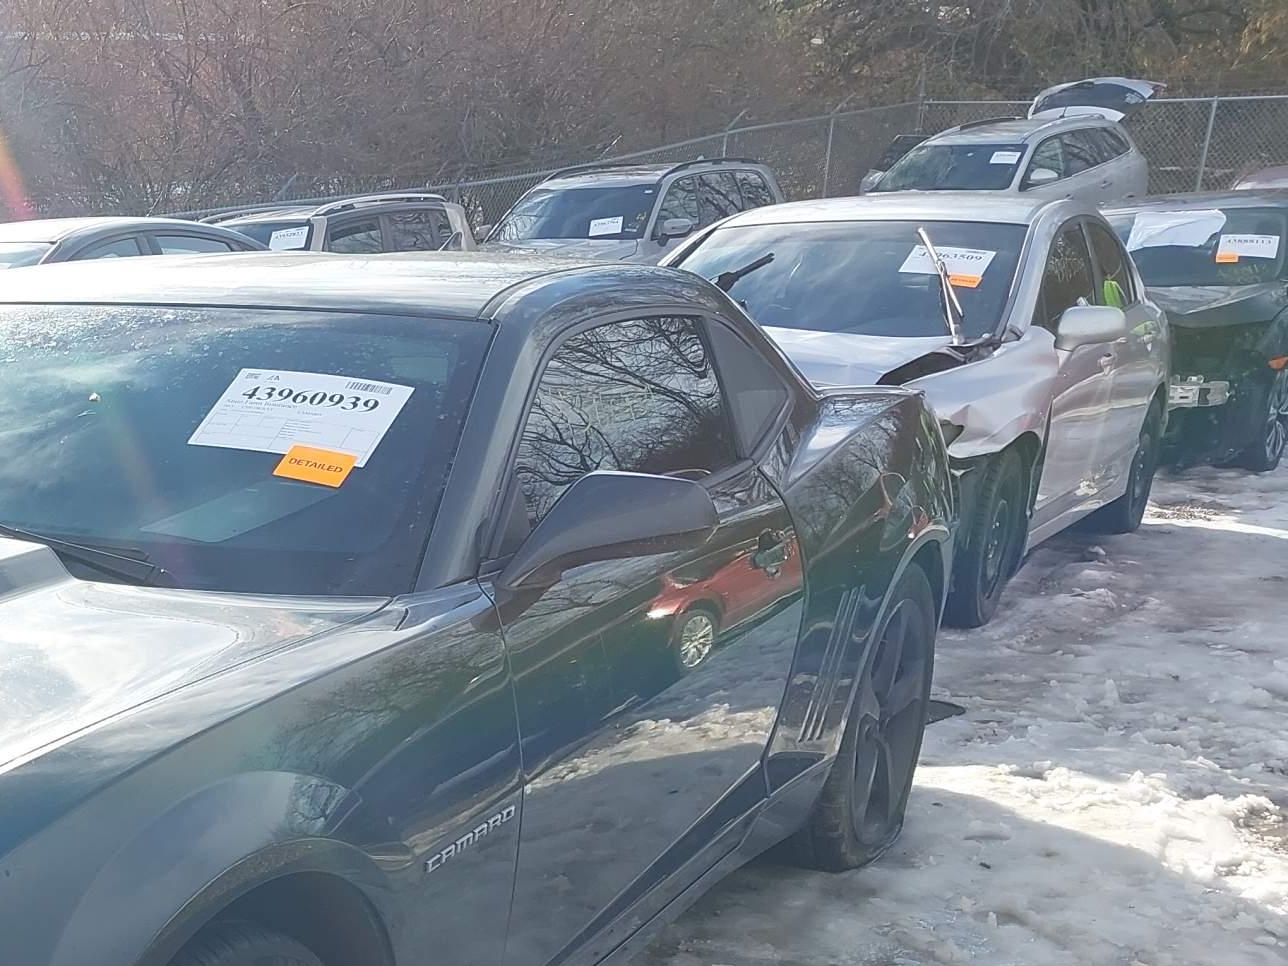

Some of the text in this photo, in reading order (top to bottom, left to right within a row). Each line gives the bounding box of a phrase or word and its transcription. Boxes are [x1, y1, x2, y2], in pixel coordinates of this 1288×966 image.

[242, 386, 379, 412] 43960939
[289, 457, 343, 473] DETAILED
[426, 805, 515, 873] CAMARO
